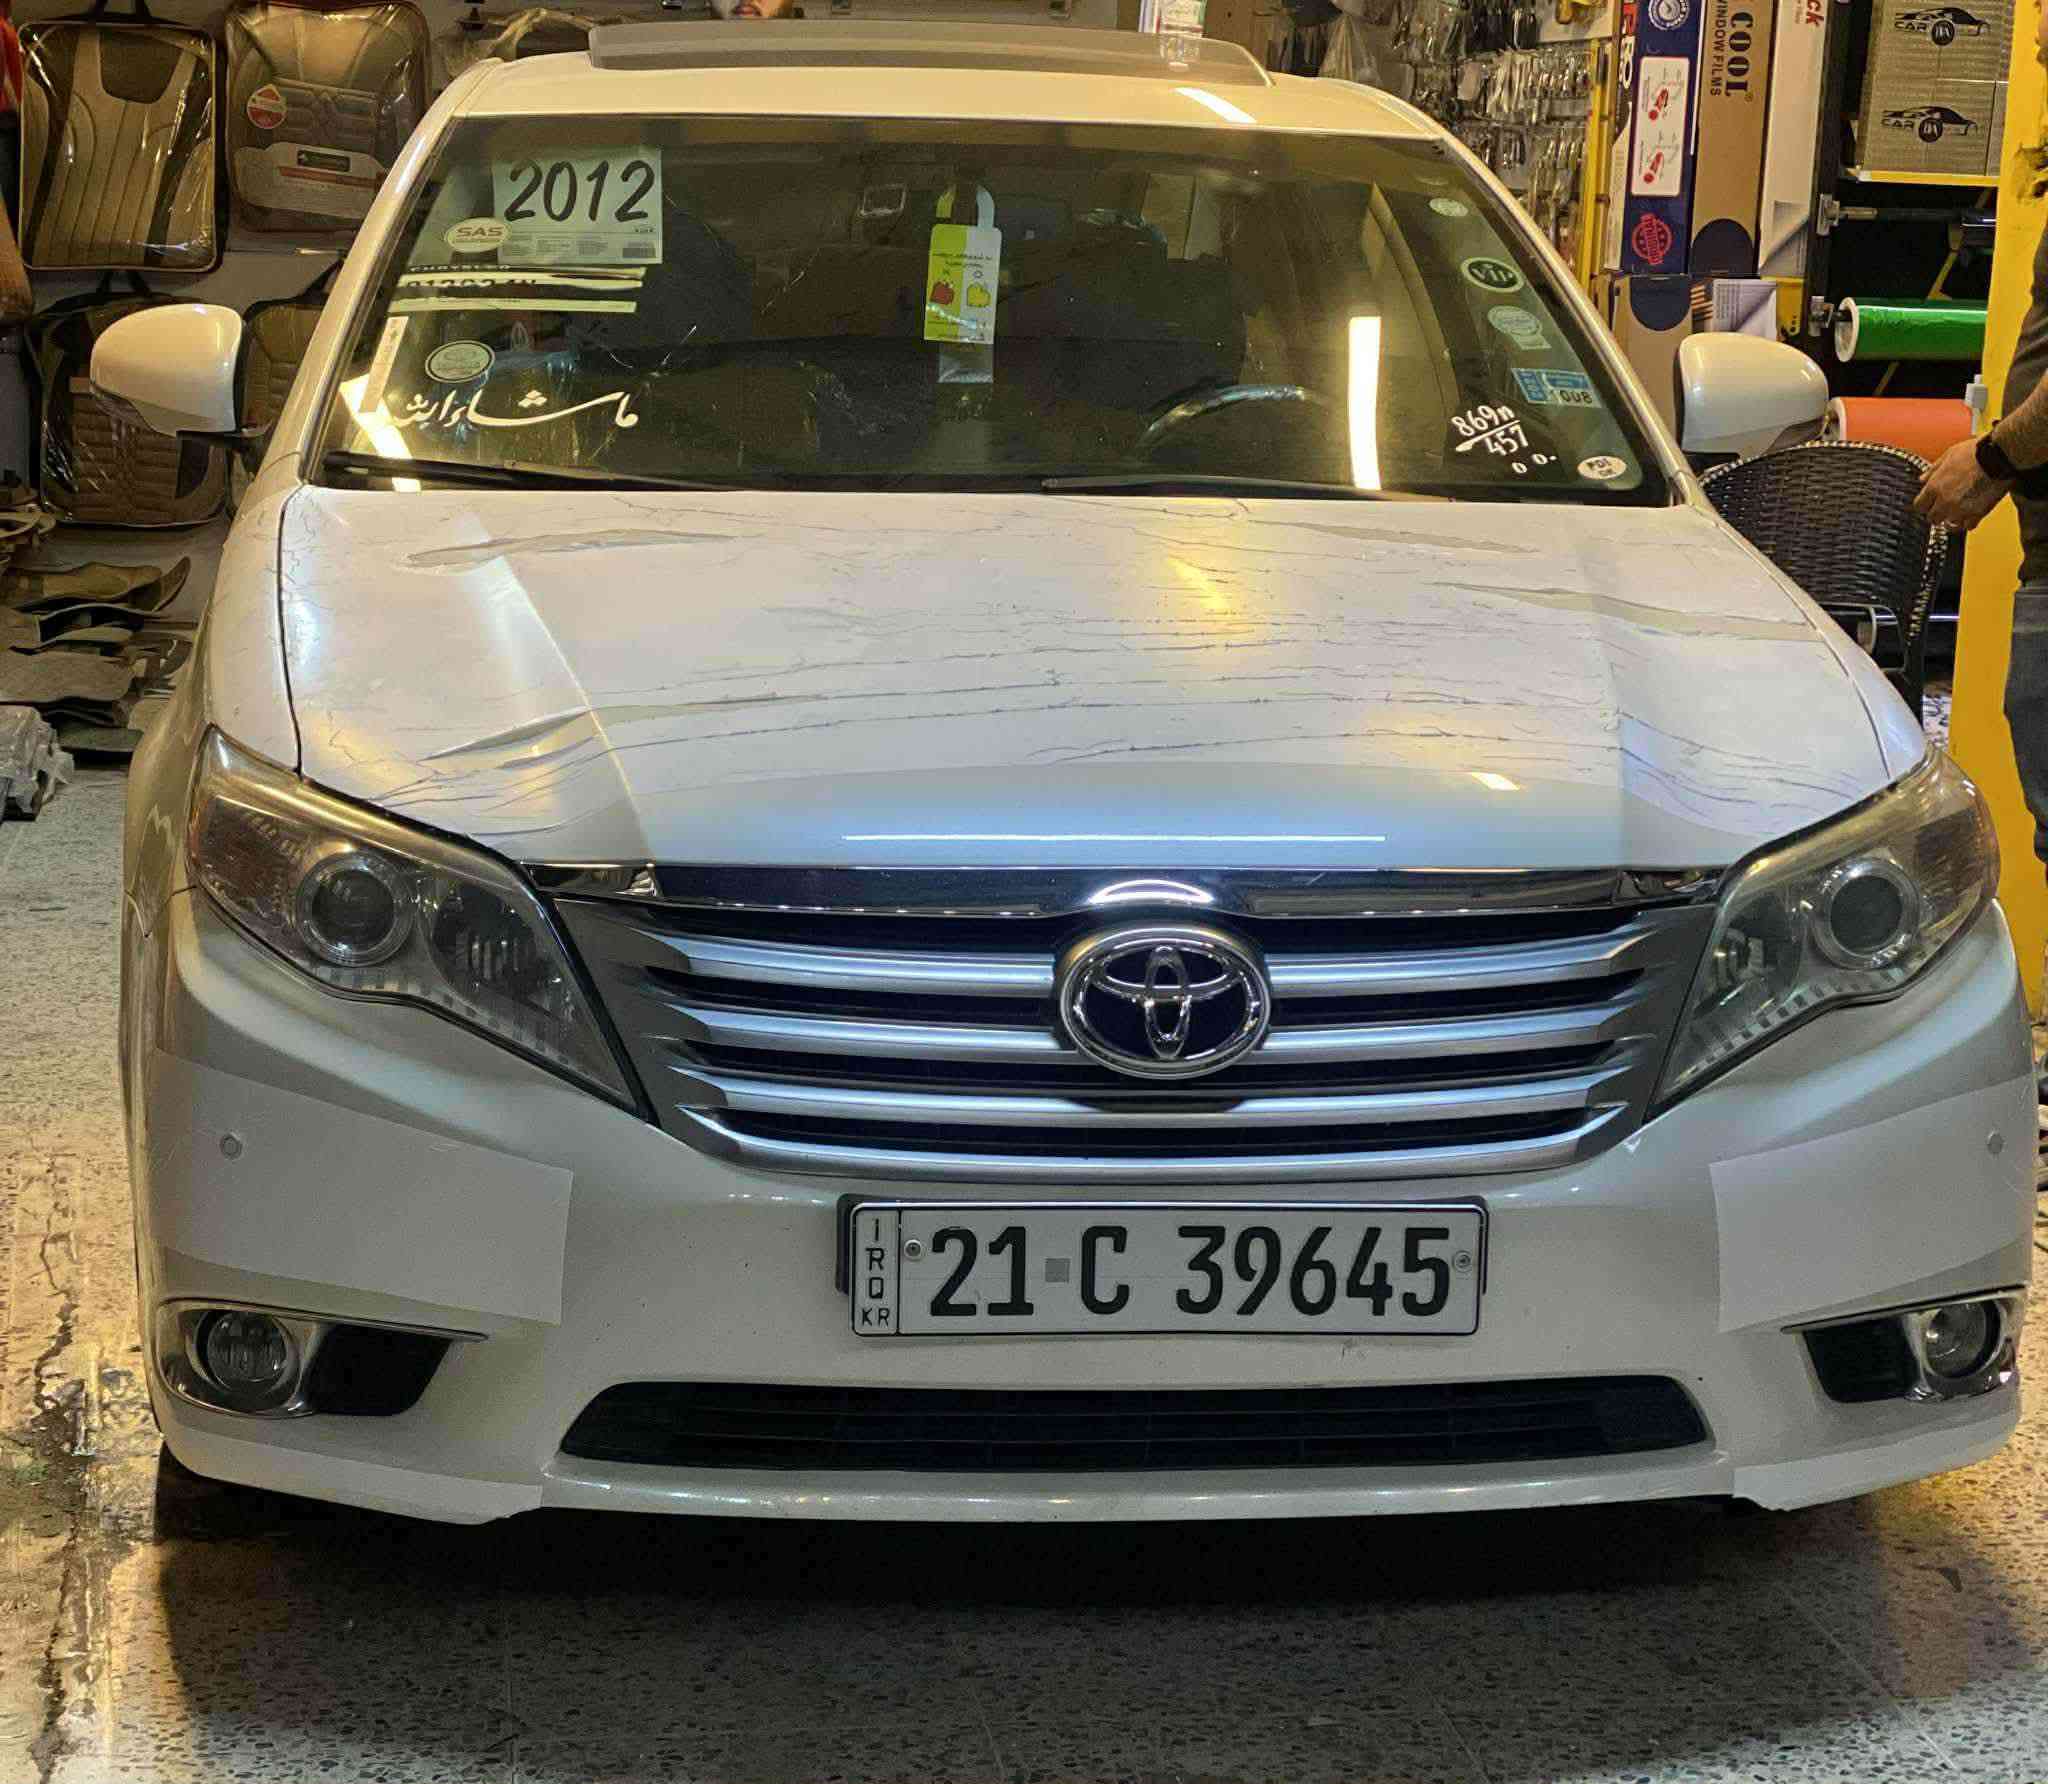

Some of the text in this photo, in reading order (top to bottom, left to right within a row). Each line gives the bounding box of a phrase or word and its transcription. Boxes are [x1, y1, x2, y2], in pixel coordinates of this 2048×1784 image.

[1710, 55, 1725, 97] FILMS
[504, 160, 655, 222] 2012
[457, 227, 504, 237] SAS
[1484, 424, 1529, 456] 457
[929, 1225, 1452, 1317] 21 C 39645
[862, 1308, 890, 1326] KR
